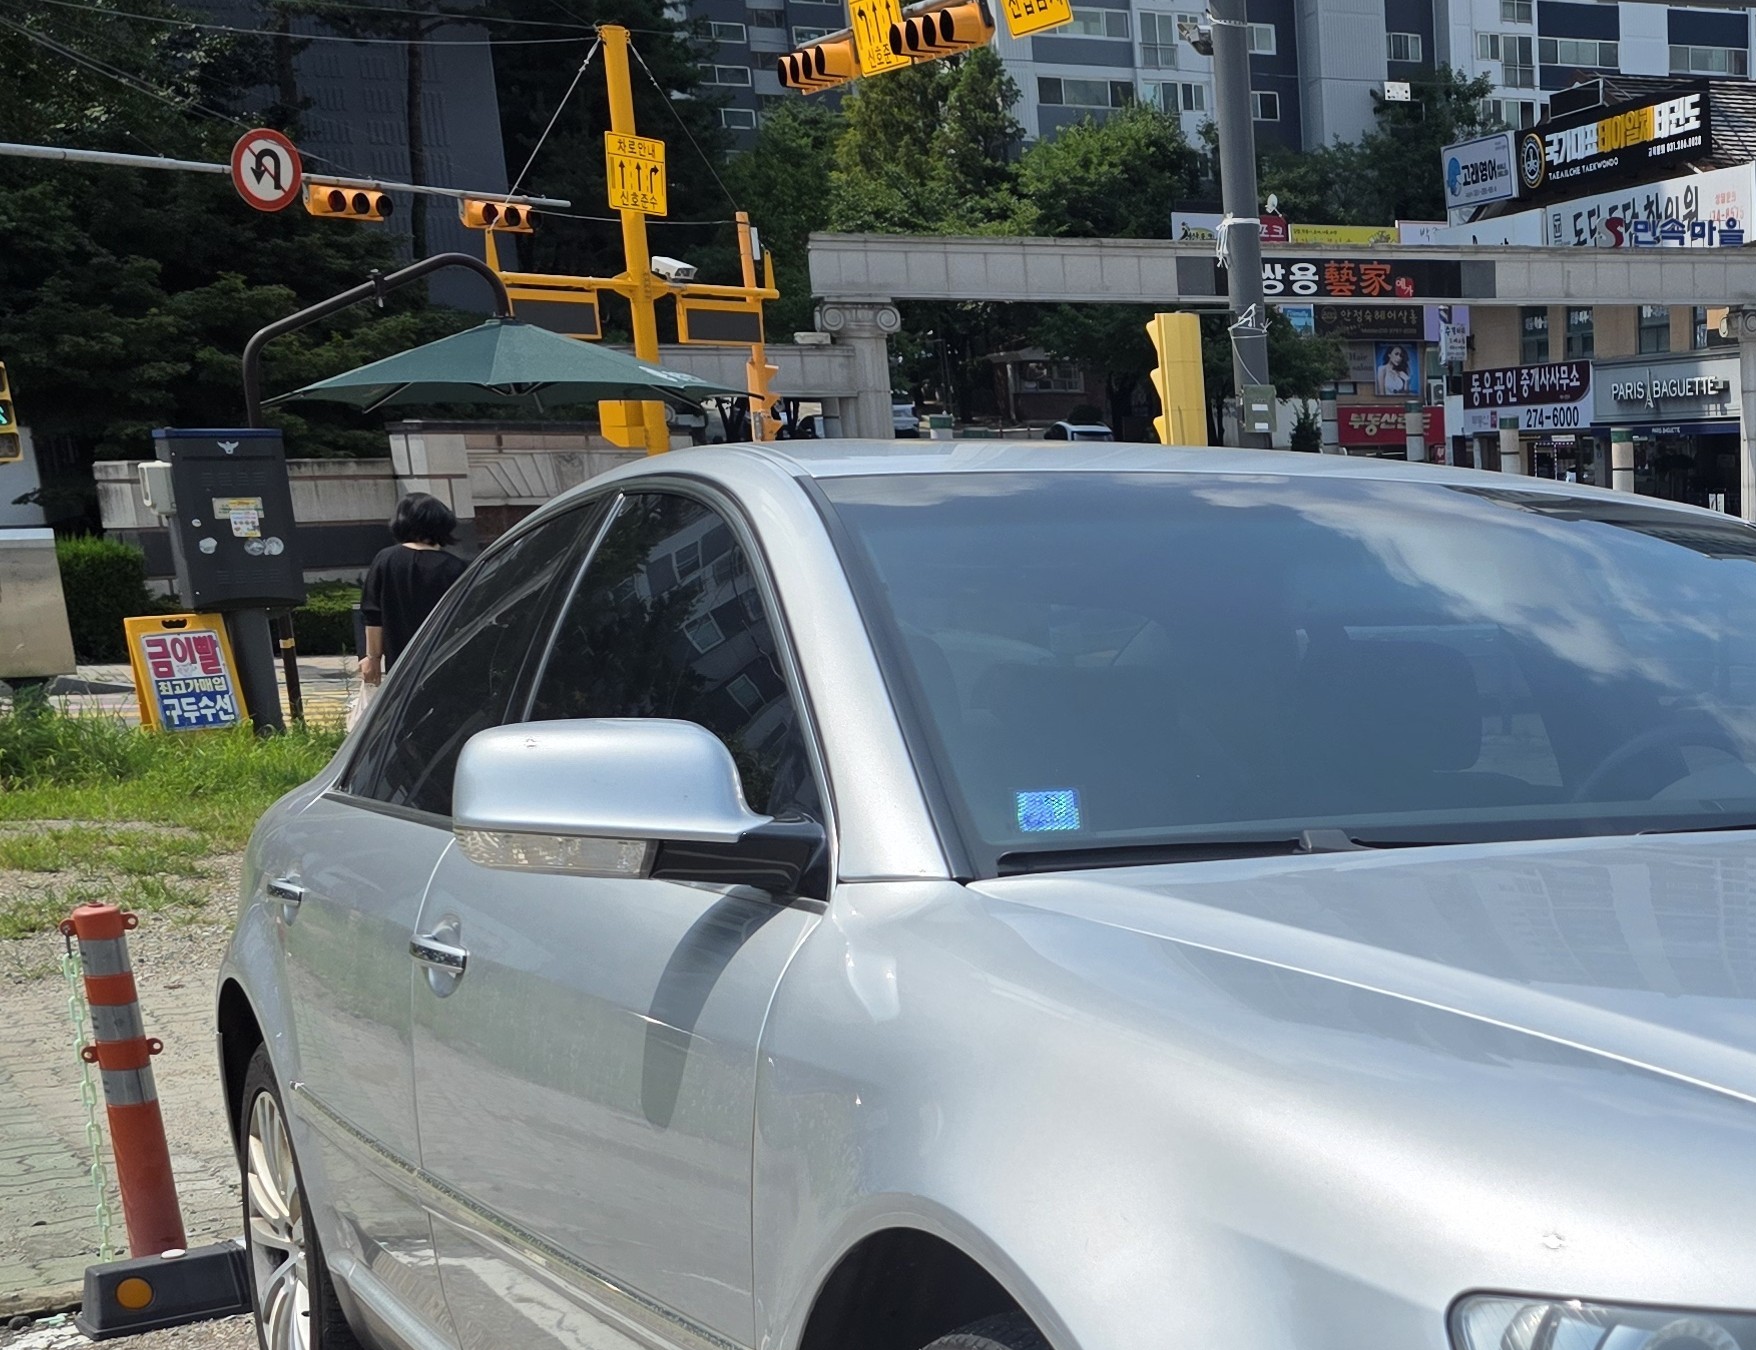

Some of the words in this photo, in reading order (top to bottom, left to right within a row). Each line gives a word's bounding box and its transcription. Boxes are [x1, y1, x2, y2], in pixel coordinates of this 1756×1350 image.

[618, 138, 656, 159] 차로안내
[621, 191, 658, 210] 신호준수
[1633, 217, 1745, 247] 민속마을
[1470, 369, 1518, 407] 동우공인
[1519, 363, 1581, 399] 중개사사무소
[1612, 380, 1645, 400] PARIS
[1652, 375, 1718, 399] BAGUETTE
[1526, 405, 1580, 428] 274-6000
[145, 634, 222, 679] 금이빨
[158, 676, 228, 696] 최고가매입
[163, 693, 235, 725] 구두수선
